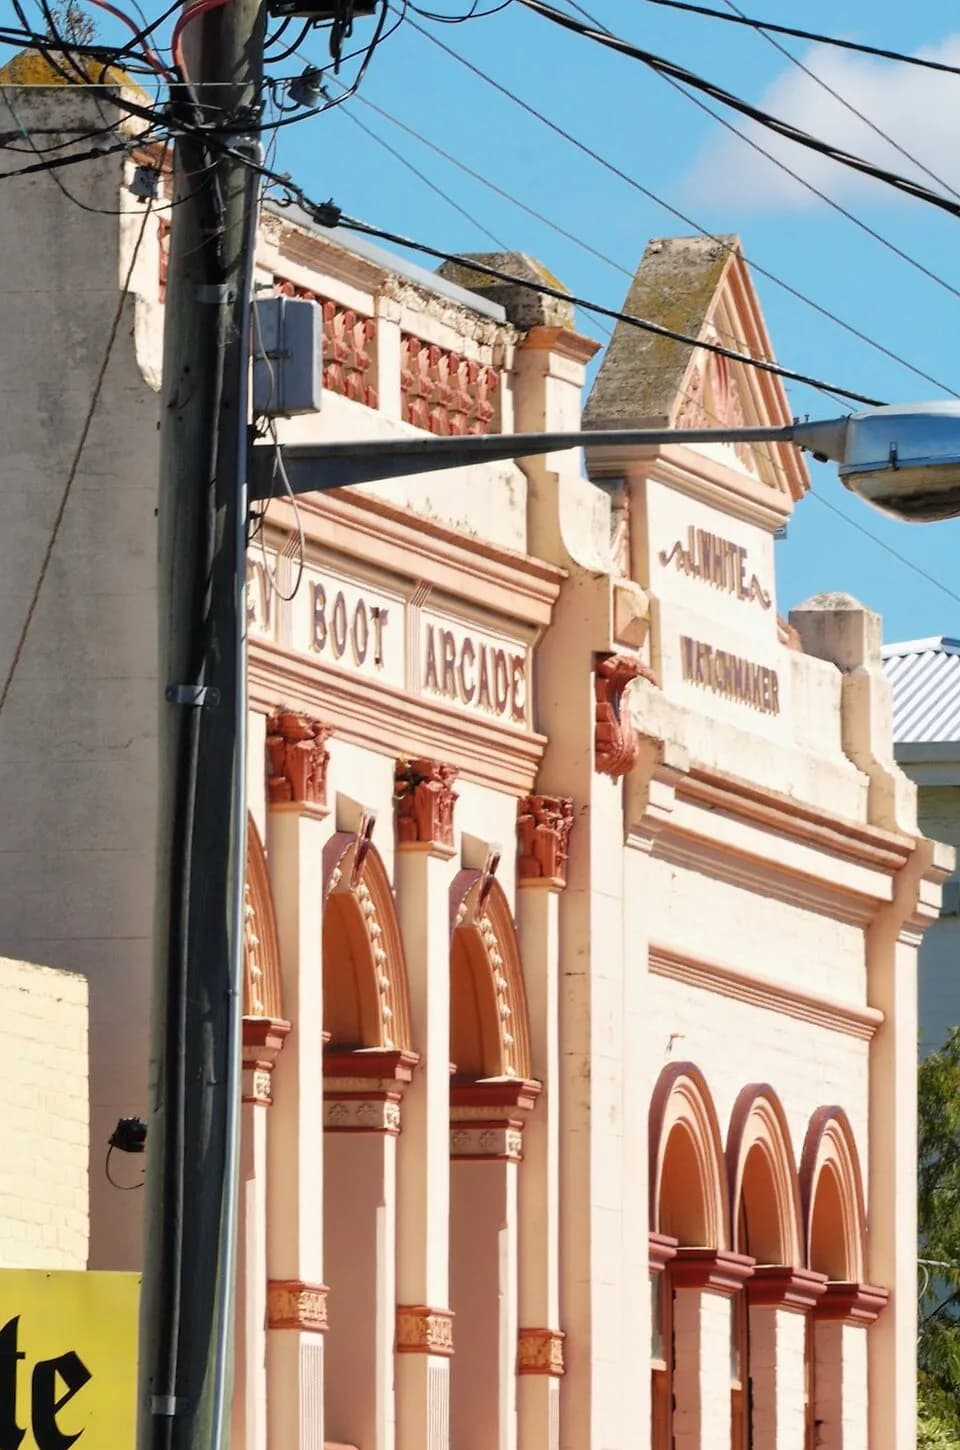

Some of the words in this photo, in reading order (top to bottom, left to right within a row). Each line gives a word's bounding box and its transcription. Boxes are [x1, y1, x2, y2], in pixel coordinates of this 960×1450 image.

[309, 580, 389, 671] BOOT
[424, 624, 527, 723] ARCADE
[681, 635, 780, 716] WATCHMAKER
